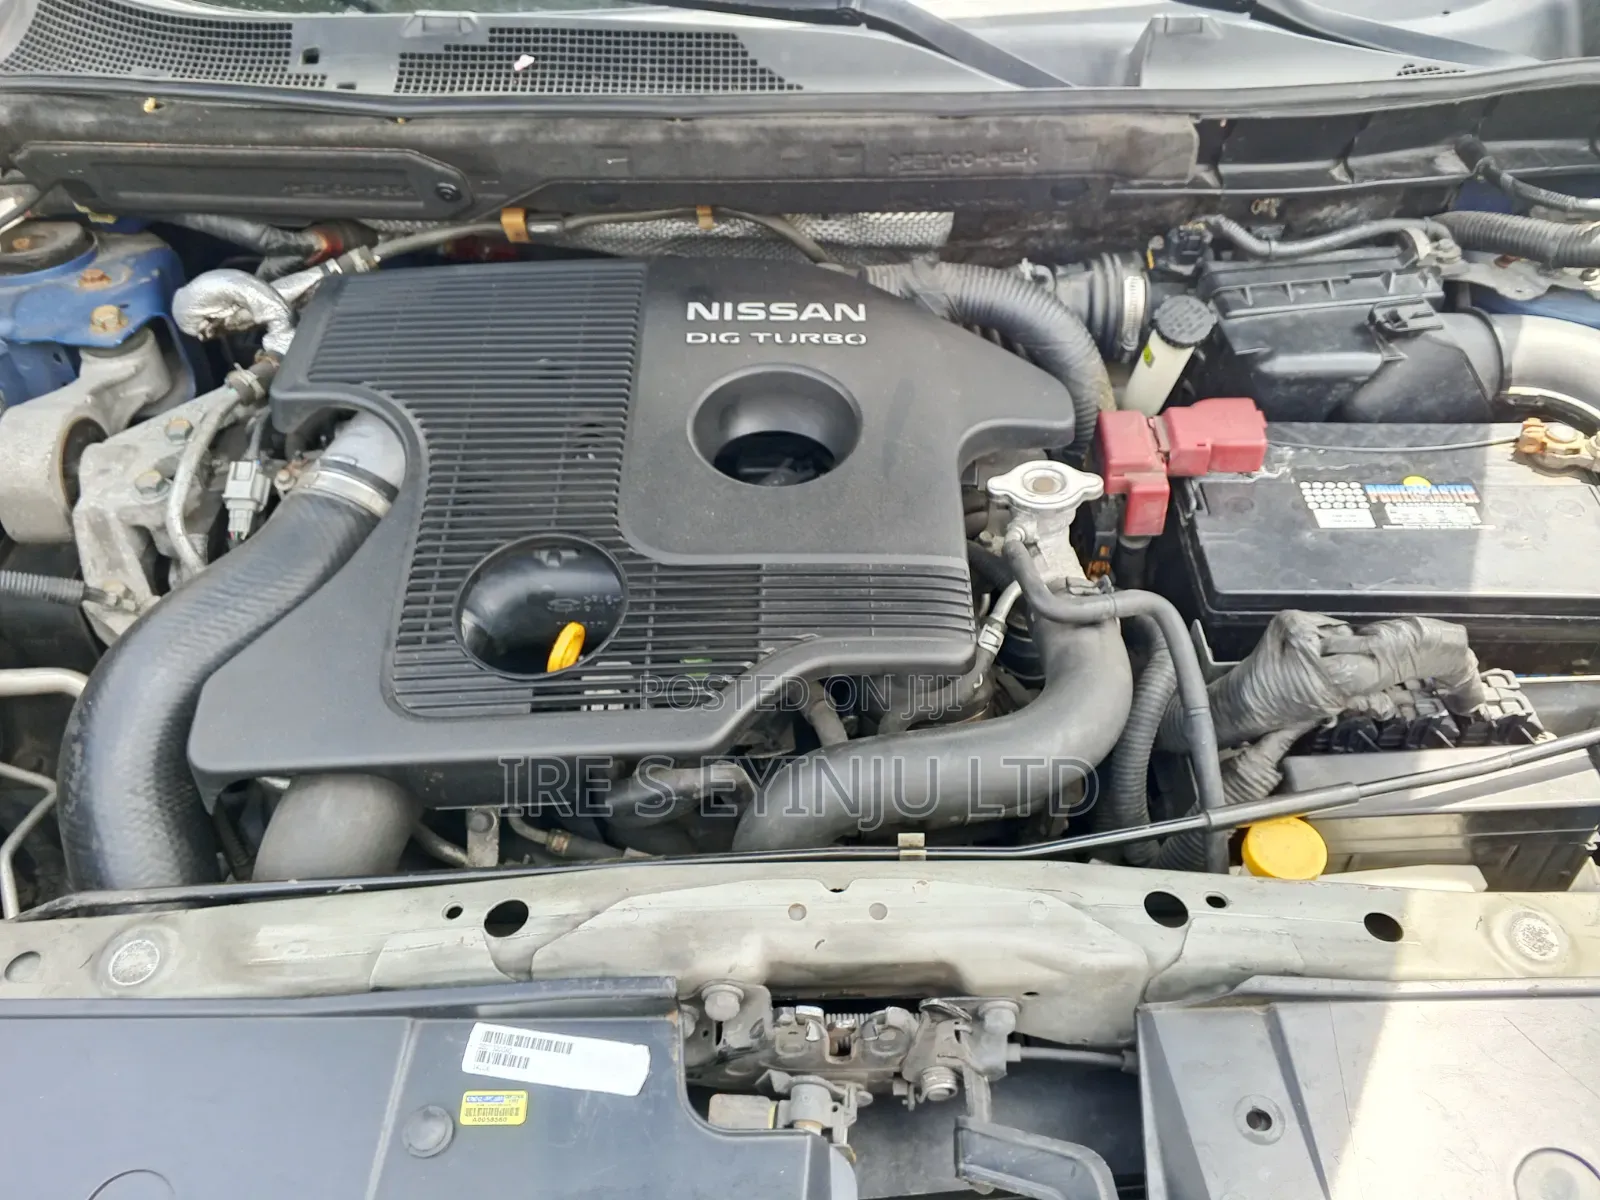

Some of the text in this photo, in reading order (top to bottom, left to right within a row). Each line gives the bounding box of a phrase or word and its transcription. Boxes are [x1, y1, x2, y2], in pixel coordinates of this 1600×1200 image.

[686, 301, 867, 322] NISSAN
[686, 332, 867, 345] DIG TURBO
